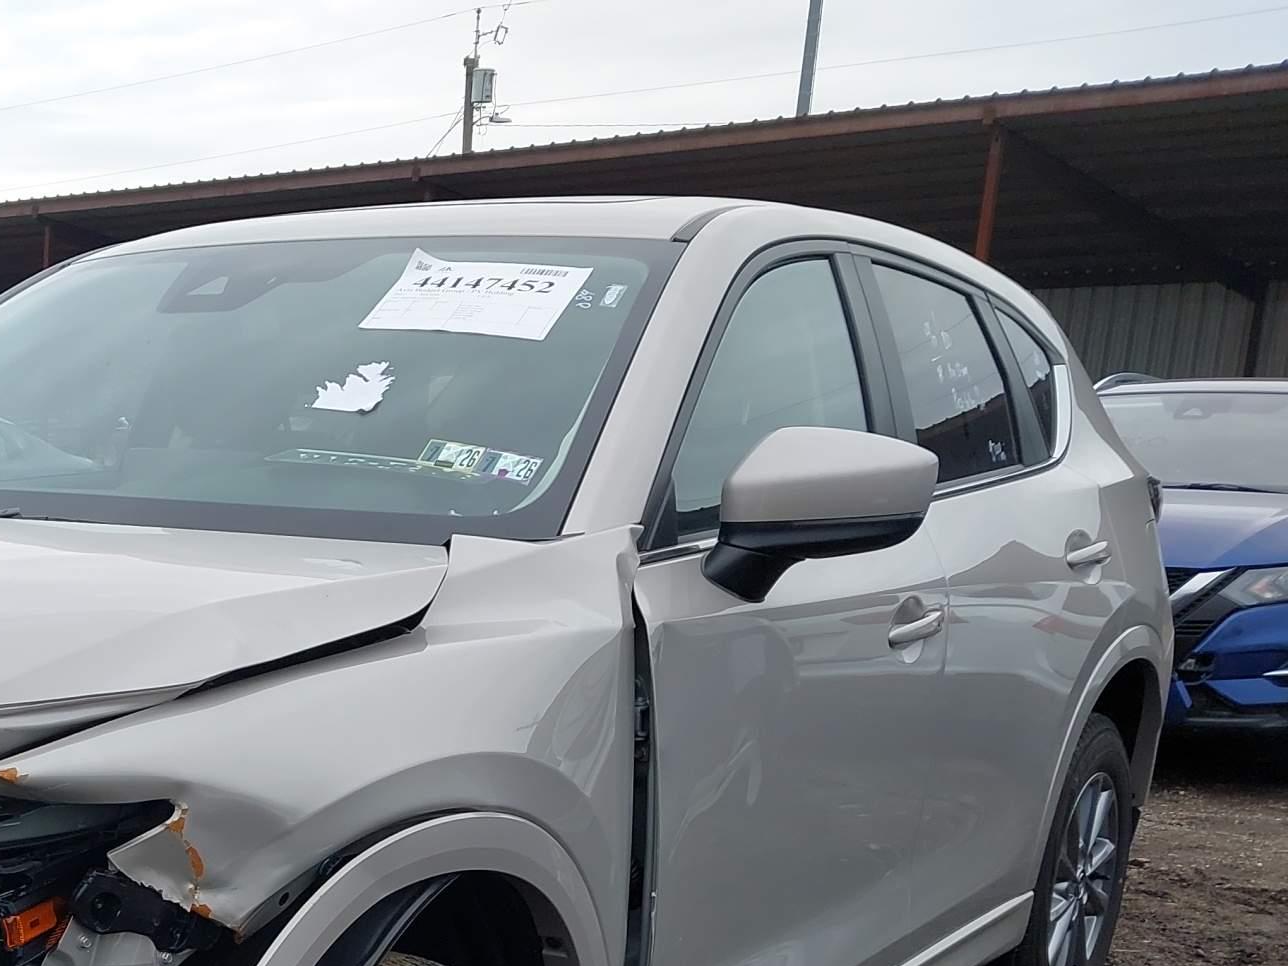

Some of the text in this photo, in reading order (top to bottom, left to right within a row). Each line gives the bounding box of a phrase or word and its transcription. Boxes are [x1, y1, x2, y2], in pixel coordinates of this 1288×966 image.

[412, 275, 556, 294] 44147452
[458, 448, 481, 469] 26
[516, 459, 538, 479] 26
